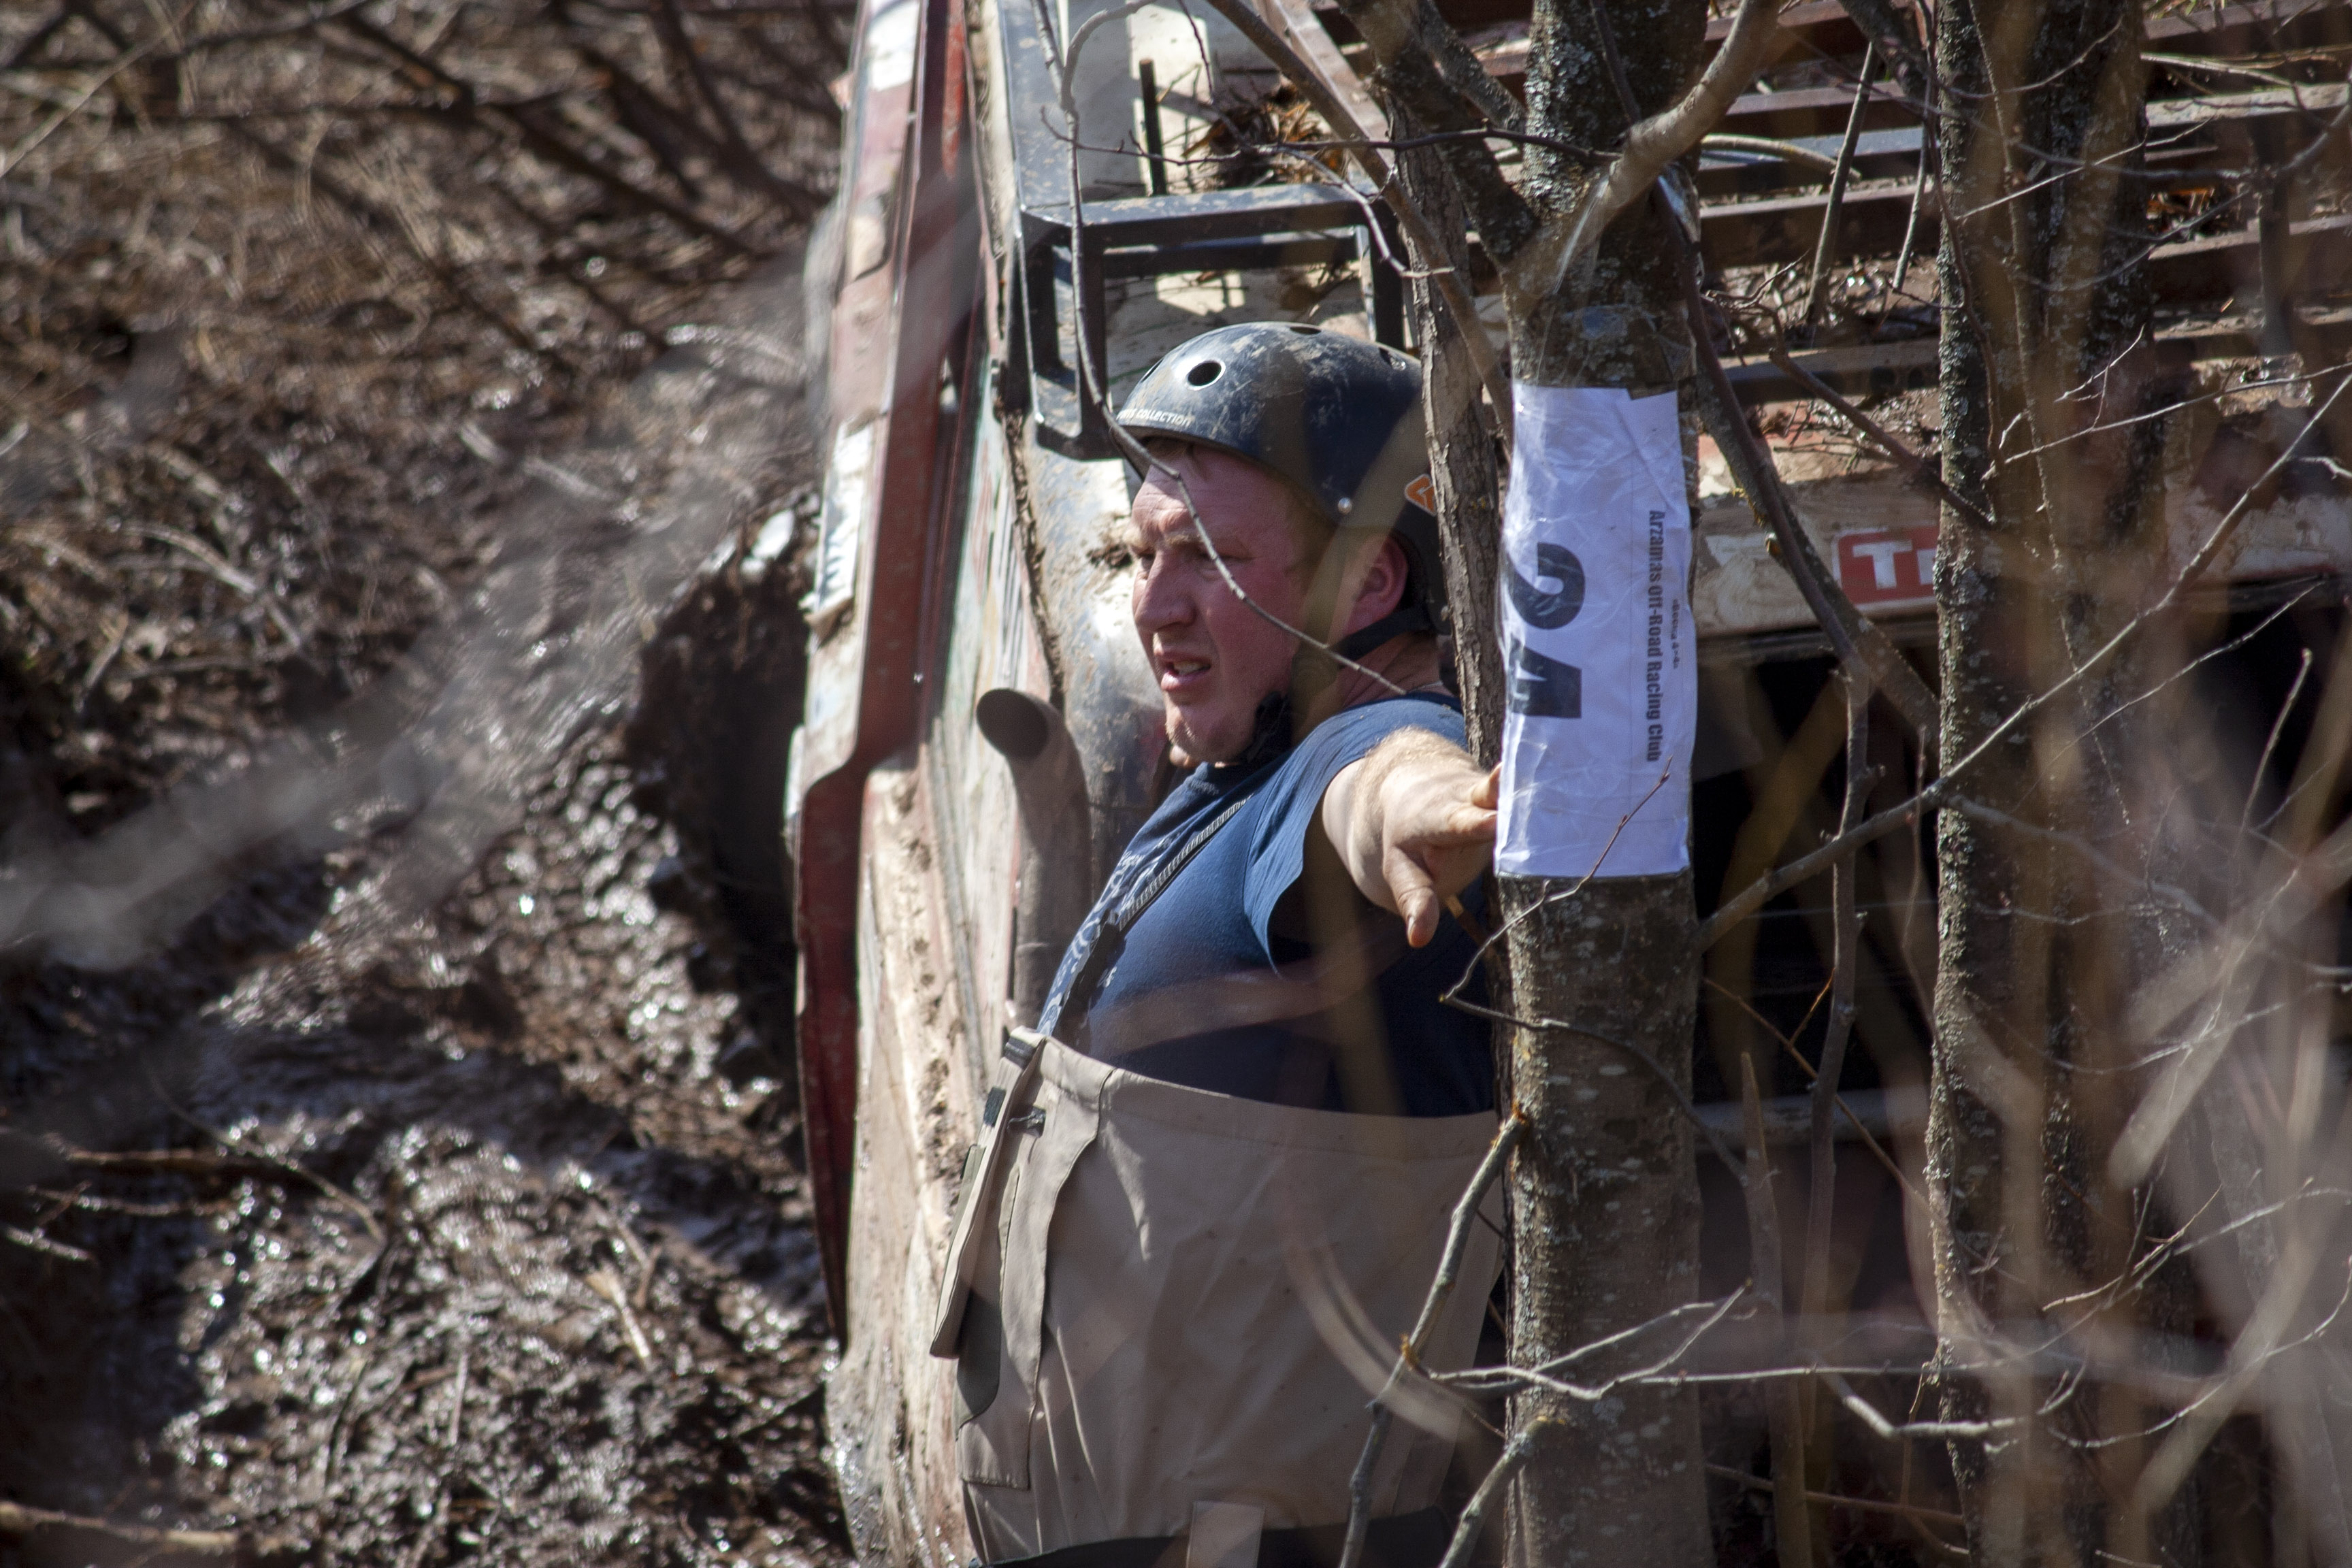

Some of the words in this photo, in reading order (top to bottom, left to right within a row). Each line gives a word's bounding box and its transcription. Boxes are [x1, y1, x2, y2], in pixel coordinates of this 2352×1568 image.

[1649, 510, 1665, 583] Arzamas
[1507, 542, 1585, 719] 24
[1648, 585, 1663, 657] Off-Road
[1646, 661, 1663, 720] Racing
[1647, 724, 1663, 762] Club
